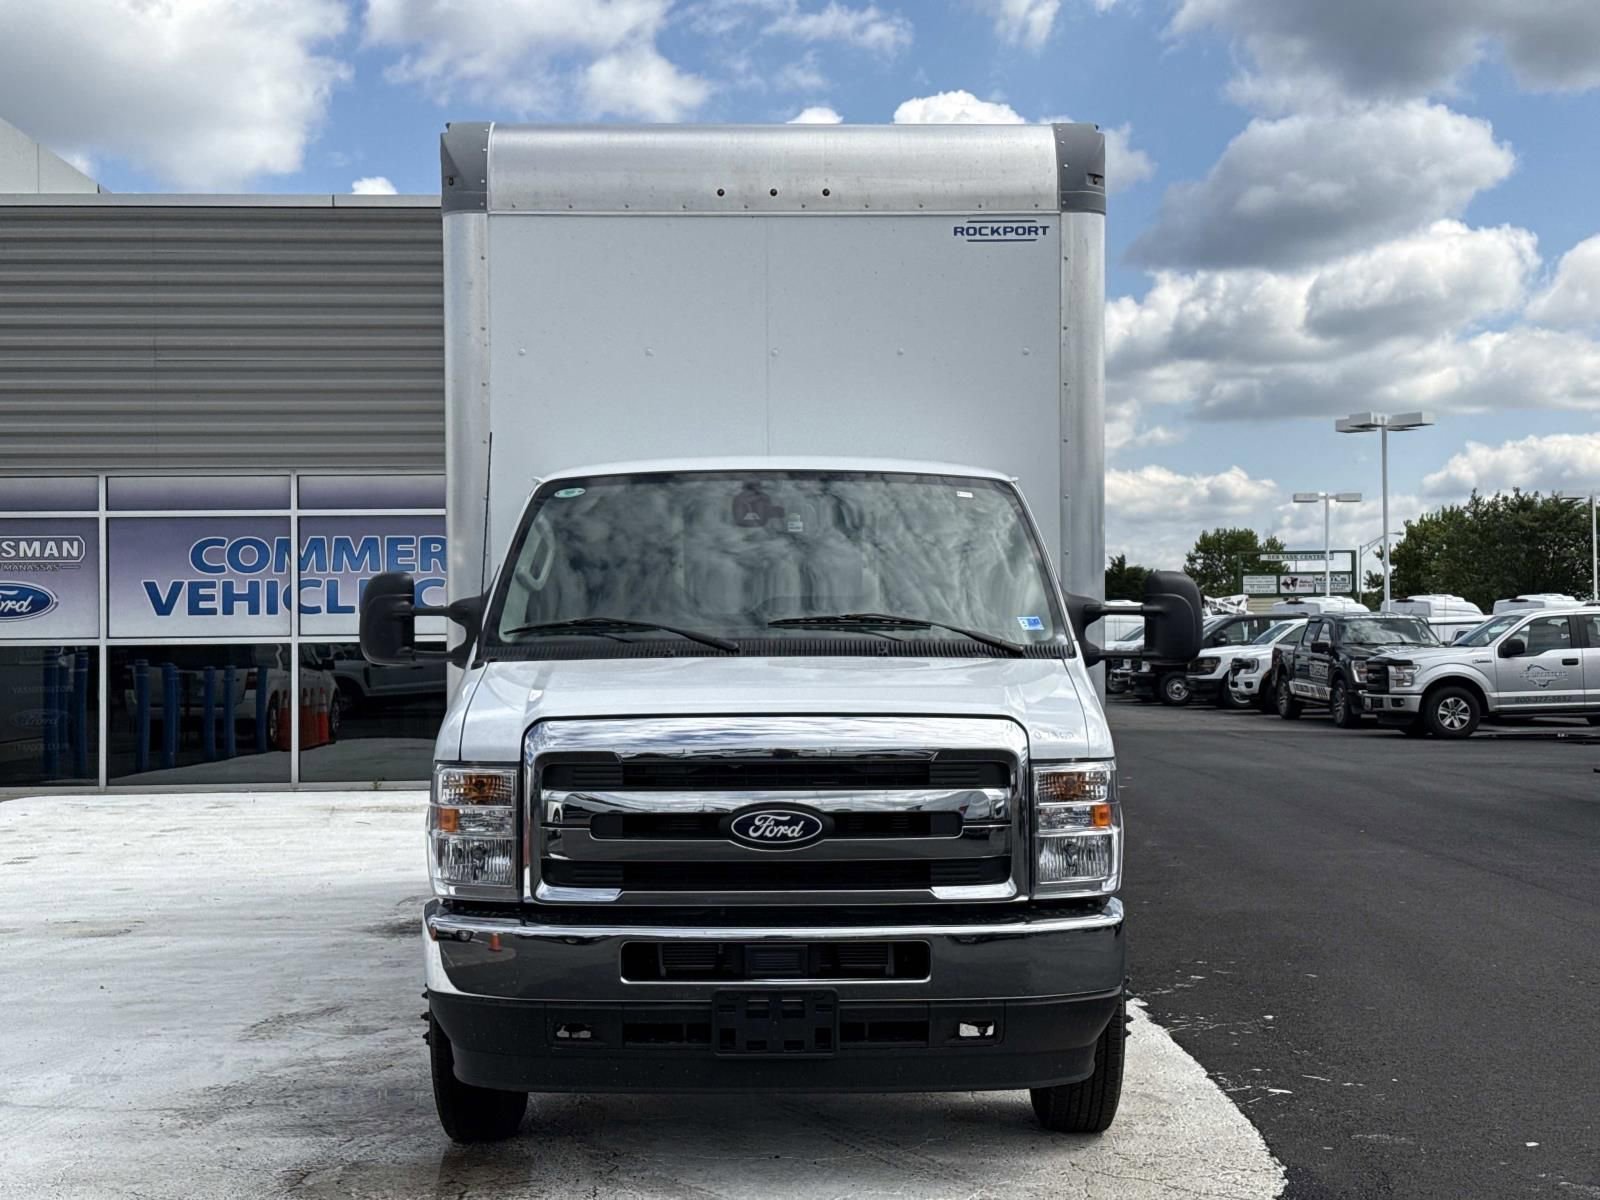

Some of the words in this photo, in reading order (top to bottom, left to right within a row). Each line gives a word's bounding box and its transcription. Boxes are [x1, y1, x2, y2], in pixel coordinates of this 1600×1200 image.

[953, 225, 1050, 237] ROCKPORT
[1, 540, 79, 558] SMAN
[189, 535, 447, 575] COMMER
[748, 814, 805, 838] Ford
